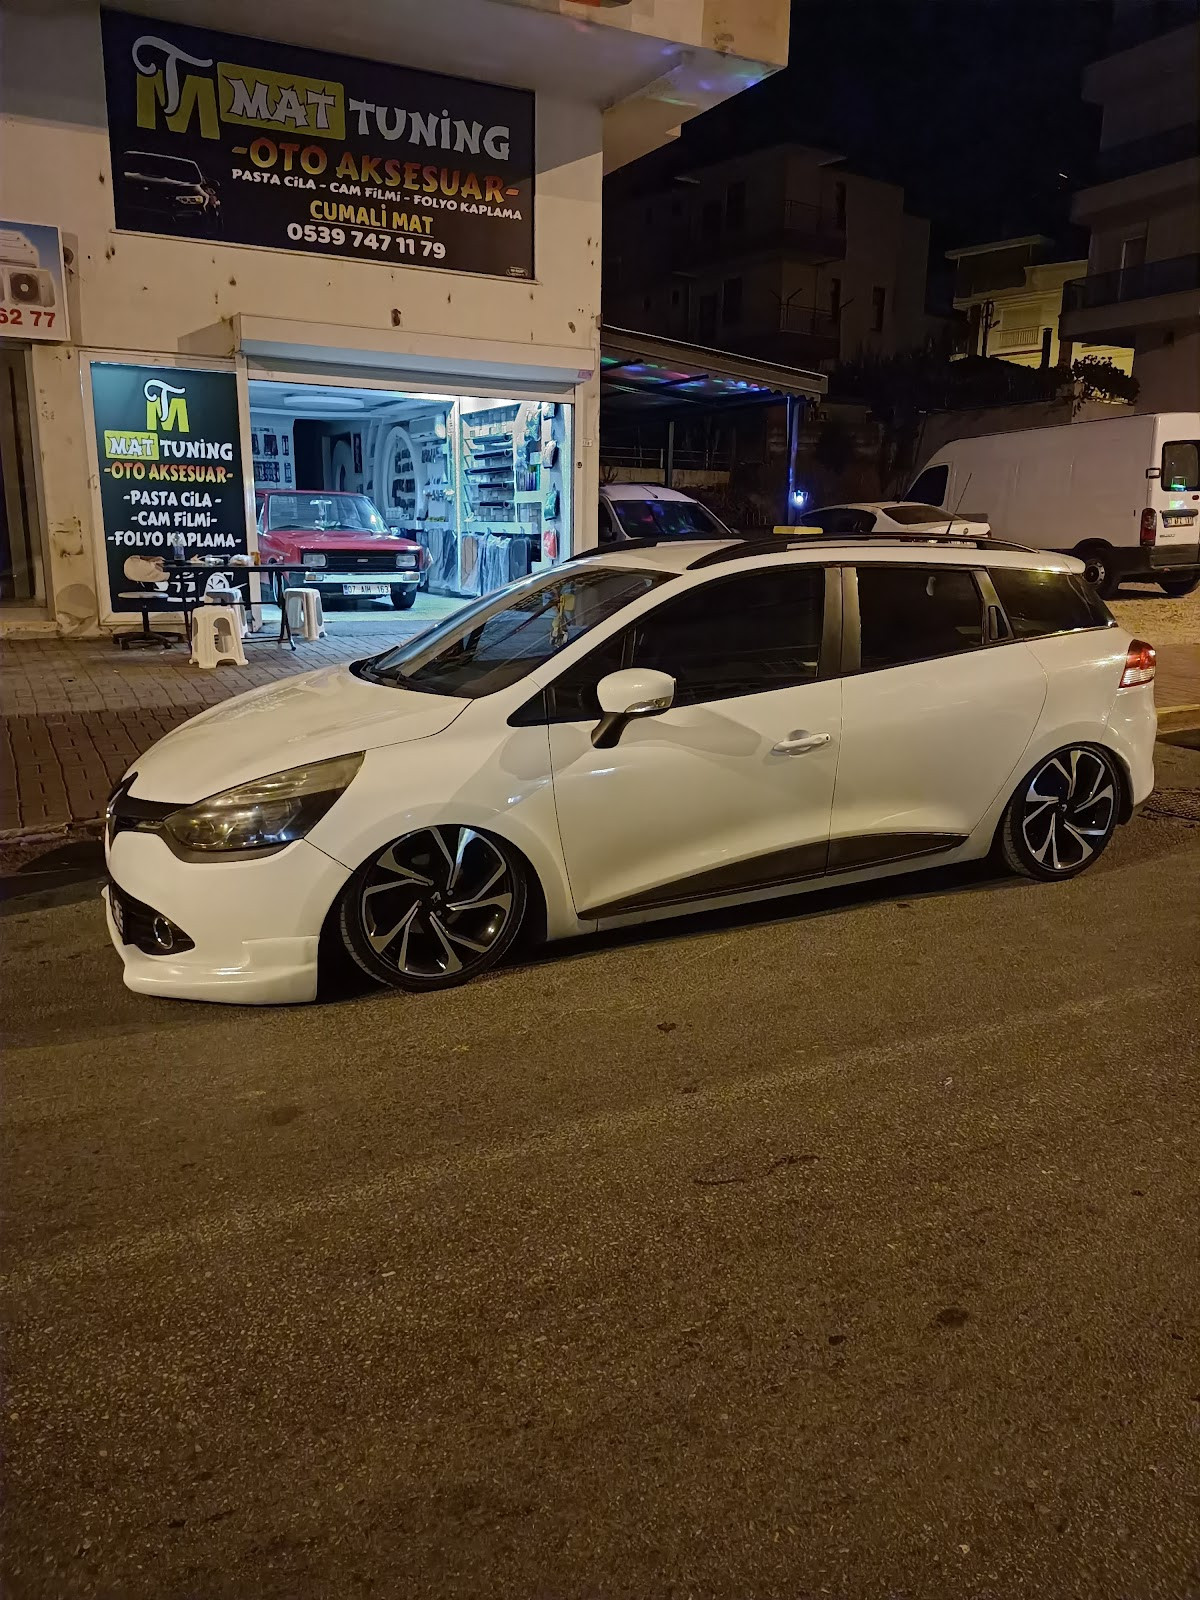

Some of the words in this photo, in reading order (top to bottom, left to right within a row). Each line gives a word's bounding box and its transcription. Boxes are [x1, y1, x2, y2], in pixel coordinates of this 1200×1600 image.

[223, 75, 336, 129] MAT
[231, 168, 281, 186] PASTA
[329, 182, 362, 197] CAM
[413, 194, 458, 211] FOLYO
[460, 202, 523, 221] KAPLAMA
[392, 211, 434, 234] MAT
[286, 222, 346, 246] 0539
[351, 230, 391, 251] 747
[396, 237, 416, 255] 11
[421, 241, 446, 259] 79
[30, 310, 56, 328] 77
[107, 434, 155, 457] MAT
